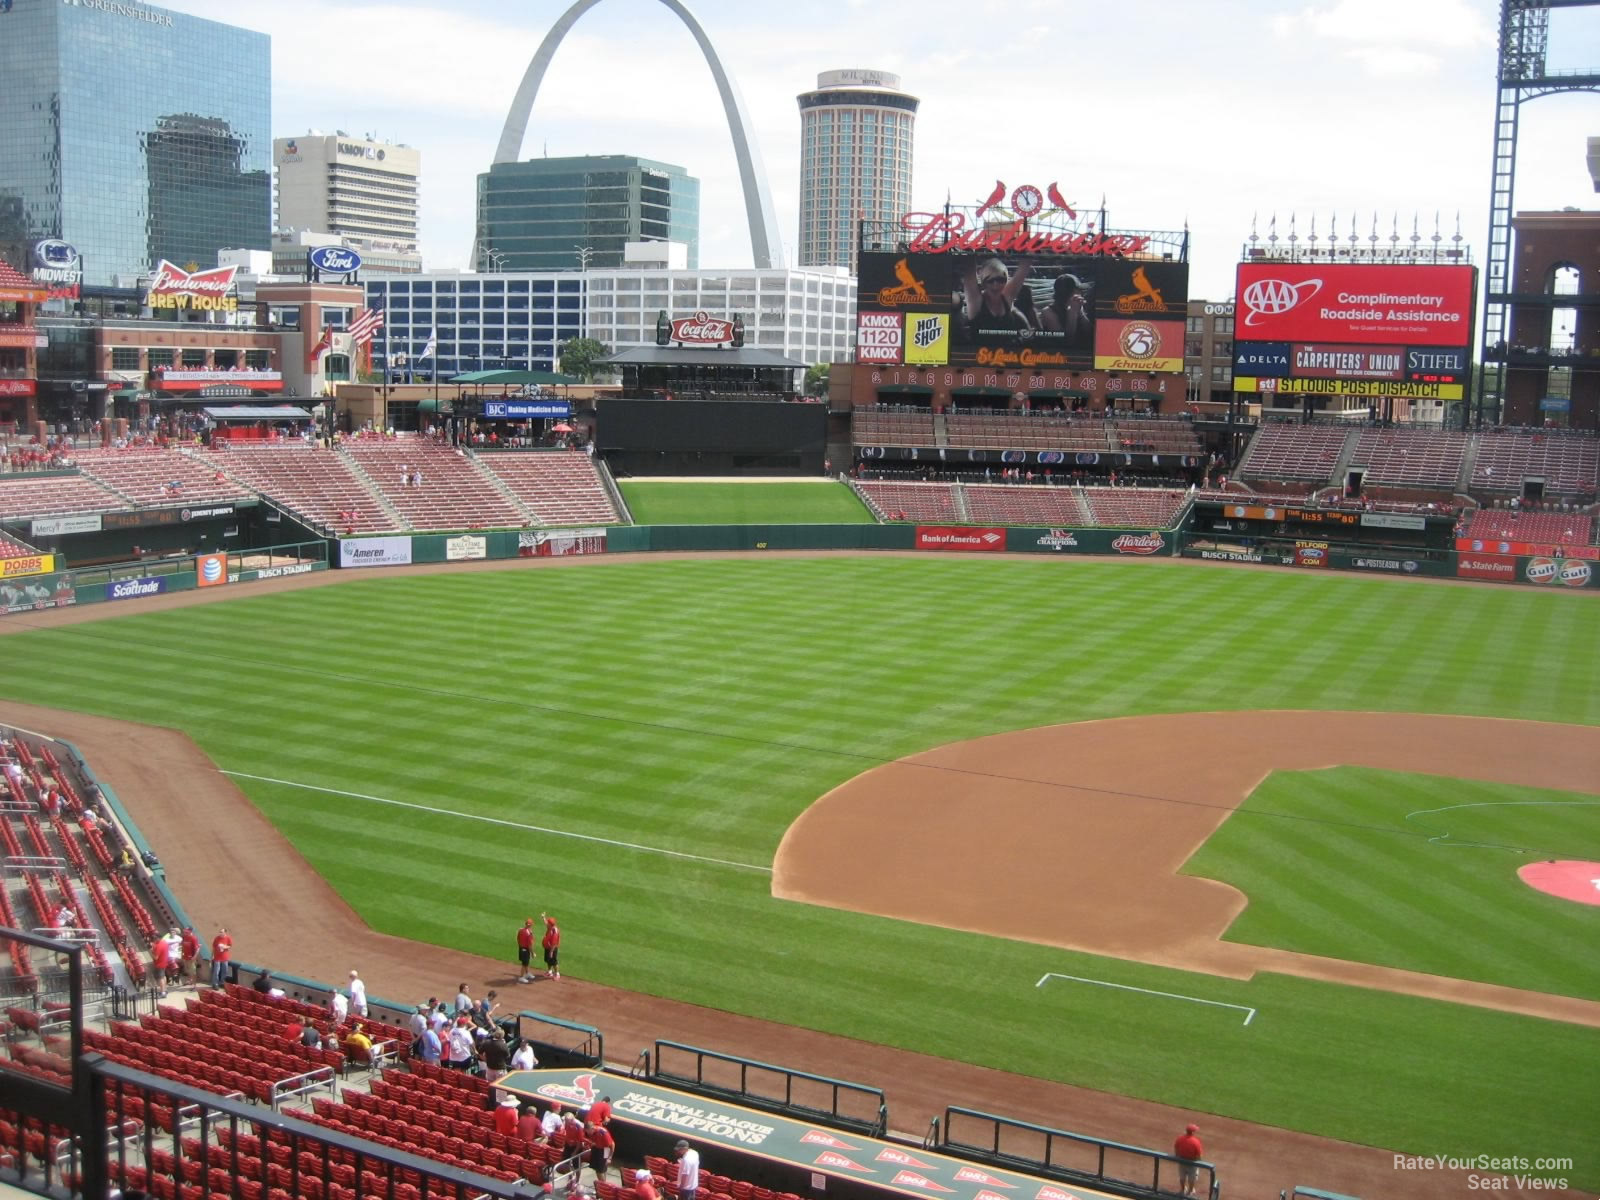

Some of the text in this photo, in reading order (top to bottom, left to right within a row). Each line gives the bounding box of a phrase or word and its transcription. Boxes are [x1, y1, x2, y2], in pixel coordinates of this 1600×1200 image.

[83, 0, 173, 27] GREENSFELDER
[338, 143, 365, 157] KMOV
[901, 211, 1151, 254] Budweiser
[45, 245, 69, 257] FOX
[1263, 246, 1448, 259] WORLD CHAMPIONS
[322, 250, 353, 268] Ford
[33, 268, 82, 282] MIDWEST
[152, 270, 236, 292] Budweiser
[148, 293, 239, 311] BREW HOUSE
[879, 287, 930, 306] Cardinals
[1250, 280, 1294, 313] AAA
[1337, 292, 1443, 307] Complimentary
[861, 315, 899, 327] KMOX
[1320, 307, 1459, 322] Roadside Assistance
[917, 317, 939, 332] HOT
[862, 330, 898, 344] 1120
[914, 327, 942, 347] SHOT
[1129, 330, 1153, 354] 75
[861, 347, 898, 359] KMOX
[1021, 348, 1065, 366] Cardinals
[1126, 349, 1154, 359] ANNIVERSARY
[1249, 355, 1287, 364] DELTA
[1109, 359, 1169, 369] Schnucks
[1296, 352, 1400, 370] CARPENTERS' UNION
[1408, 352, 1463, 370] STIFEL
[894, 372, 1147, 391] 1 2 6 9 10 14 17 20 24 42 45 85
[1281, 378, 1439, 397] ST. LOUIS POST-DISPATCH
[488, 404, 504, 414] BJC
[508, 406, 527, 414] Making
[191, 507, 233, 518] JIMMY JOHN'S
[1302, 513, 1322, 521] 11:55
[36, 525, 56, 533] Mercy
[922, 534, 941, 542] Bank
[1296, 541, 1328, 549] STLFORD
[353, 549, 384, 558] Ameren
[1202, 551, 1261, 562] BUSCH STADIUM
[4, 558, 42, 570] DOBBS
[1366, 559, 1399, 569] POSTSEASON
[1472, 561, 1513, 571] State Farm
[1528, 564, 1556, 576] Gulf
[258, 564, 312, 579] BUSCH STADIUM
[1561, 567, 1588, 579] Gulf
[113, 581, 159, 597] Scottrade
[623, 1092, 774, 1135] NATIONAL LEAGUE
[613, 1099, 768, 1144] CHAMPIONS
[822, 1155, 850, 1167] 1930
[899, 1174, 928, 1185] 1968
[960, 1170, 988, 1181] 1985
